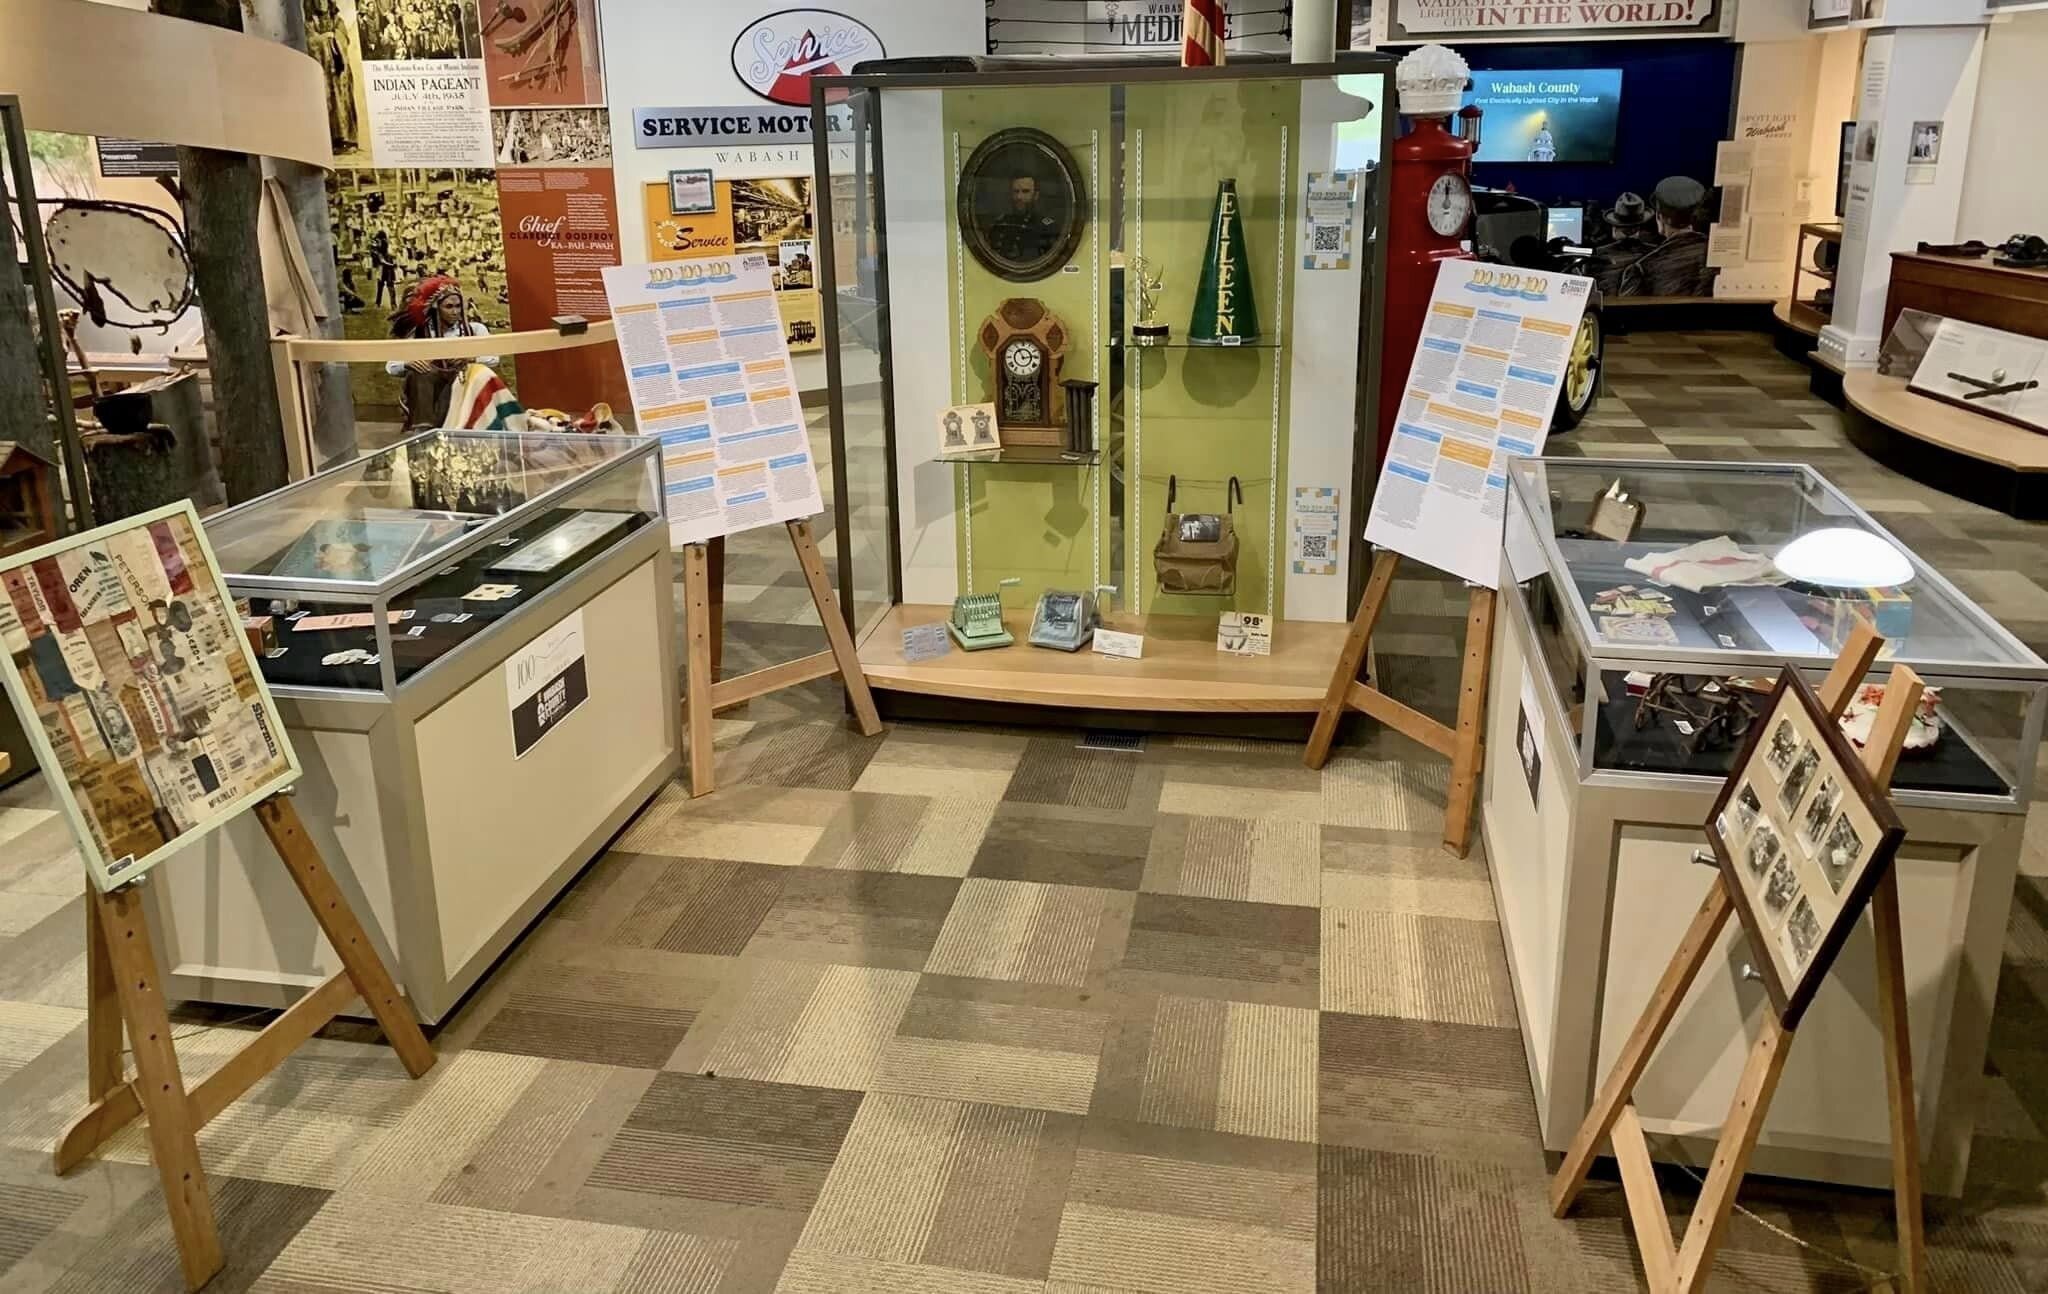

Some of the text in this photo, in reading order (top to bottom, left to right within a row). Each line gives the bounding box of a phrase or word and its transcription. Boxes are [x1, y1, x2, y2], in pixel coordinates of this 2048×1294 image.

[1420, 9, 1474, 18] LIGHTED
[1476, 7, 1507, 26] IN
[1512, 6, 1571, 24] THE
[1577, 0, 1694, 23] WORLD!
[751, 26, 869, 84] Service
[373, 77, 482, 92] INDIAN PAGEANT
[1491, 82, 1580, 95] Wabash County
[391, 93, 418, 101] JULY
[643, 117, 752, 136] SERVICE
[716, 151, 800, 163] WABASH
[519, 214, 567, 247] Chief
[564, 232, 614, 240] GODFROY
[673, 227, 729, 251] Service
[1215, 192, 1236, 336] EILEEN
[69, 566, 92, 593] OREN
[26, 574, 47, 612] TAYLOR
[252, 702, 278, 758] Sherman
